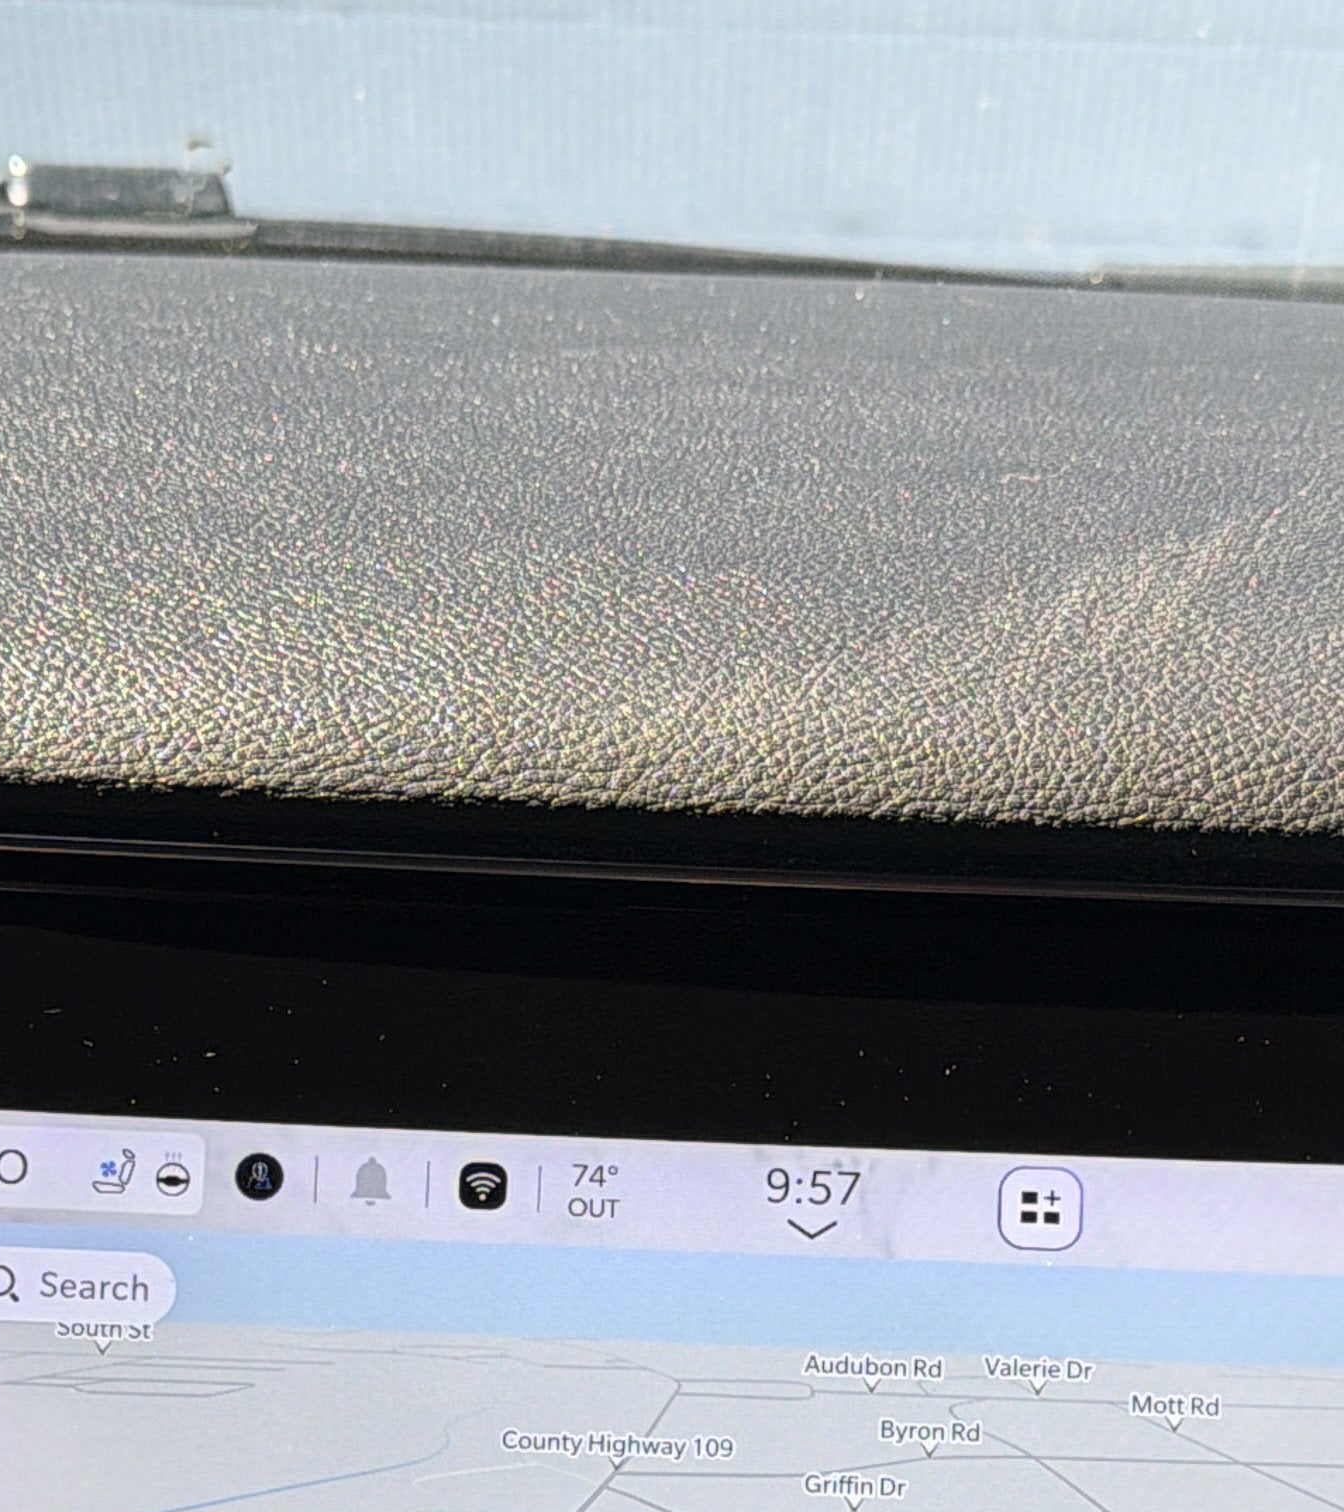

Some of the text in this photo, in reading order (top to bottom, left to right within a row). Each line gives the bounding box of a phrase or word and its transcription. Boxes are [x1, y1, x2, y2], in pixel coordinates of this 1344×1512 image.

[570, 1163, 620, 1189] 74°
[765, 1167, 860, 1208] 9:57
[567, 1197, 621, 1219] OUT
[39, 1271, 149, 1304] Search
[804, 1355, 944, 1379] Audubon Rd
[985, 1357, 1093, 1381] Valerie Dr
[1131, 1394, 1221, 1417] Mott Rd
[881, 1421, 981, 1446] Byron Rd
[501, 1430, 734, 1462] County Highway 109
[804, 1474, 906, 1498] Griffin Dr
